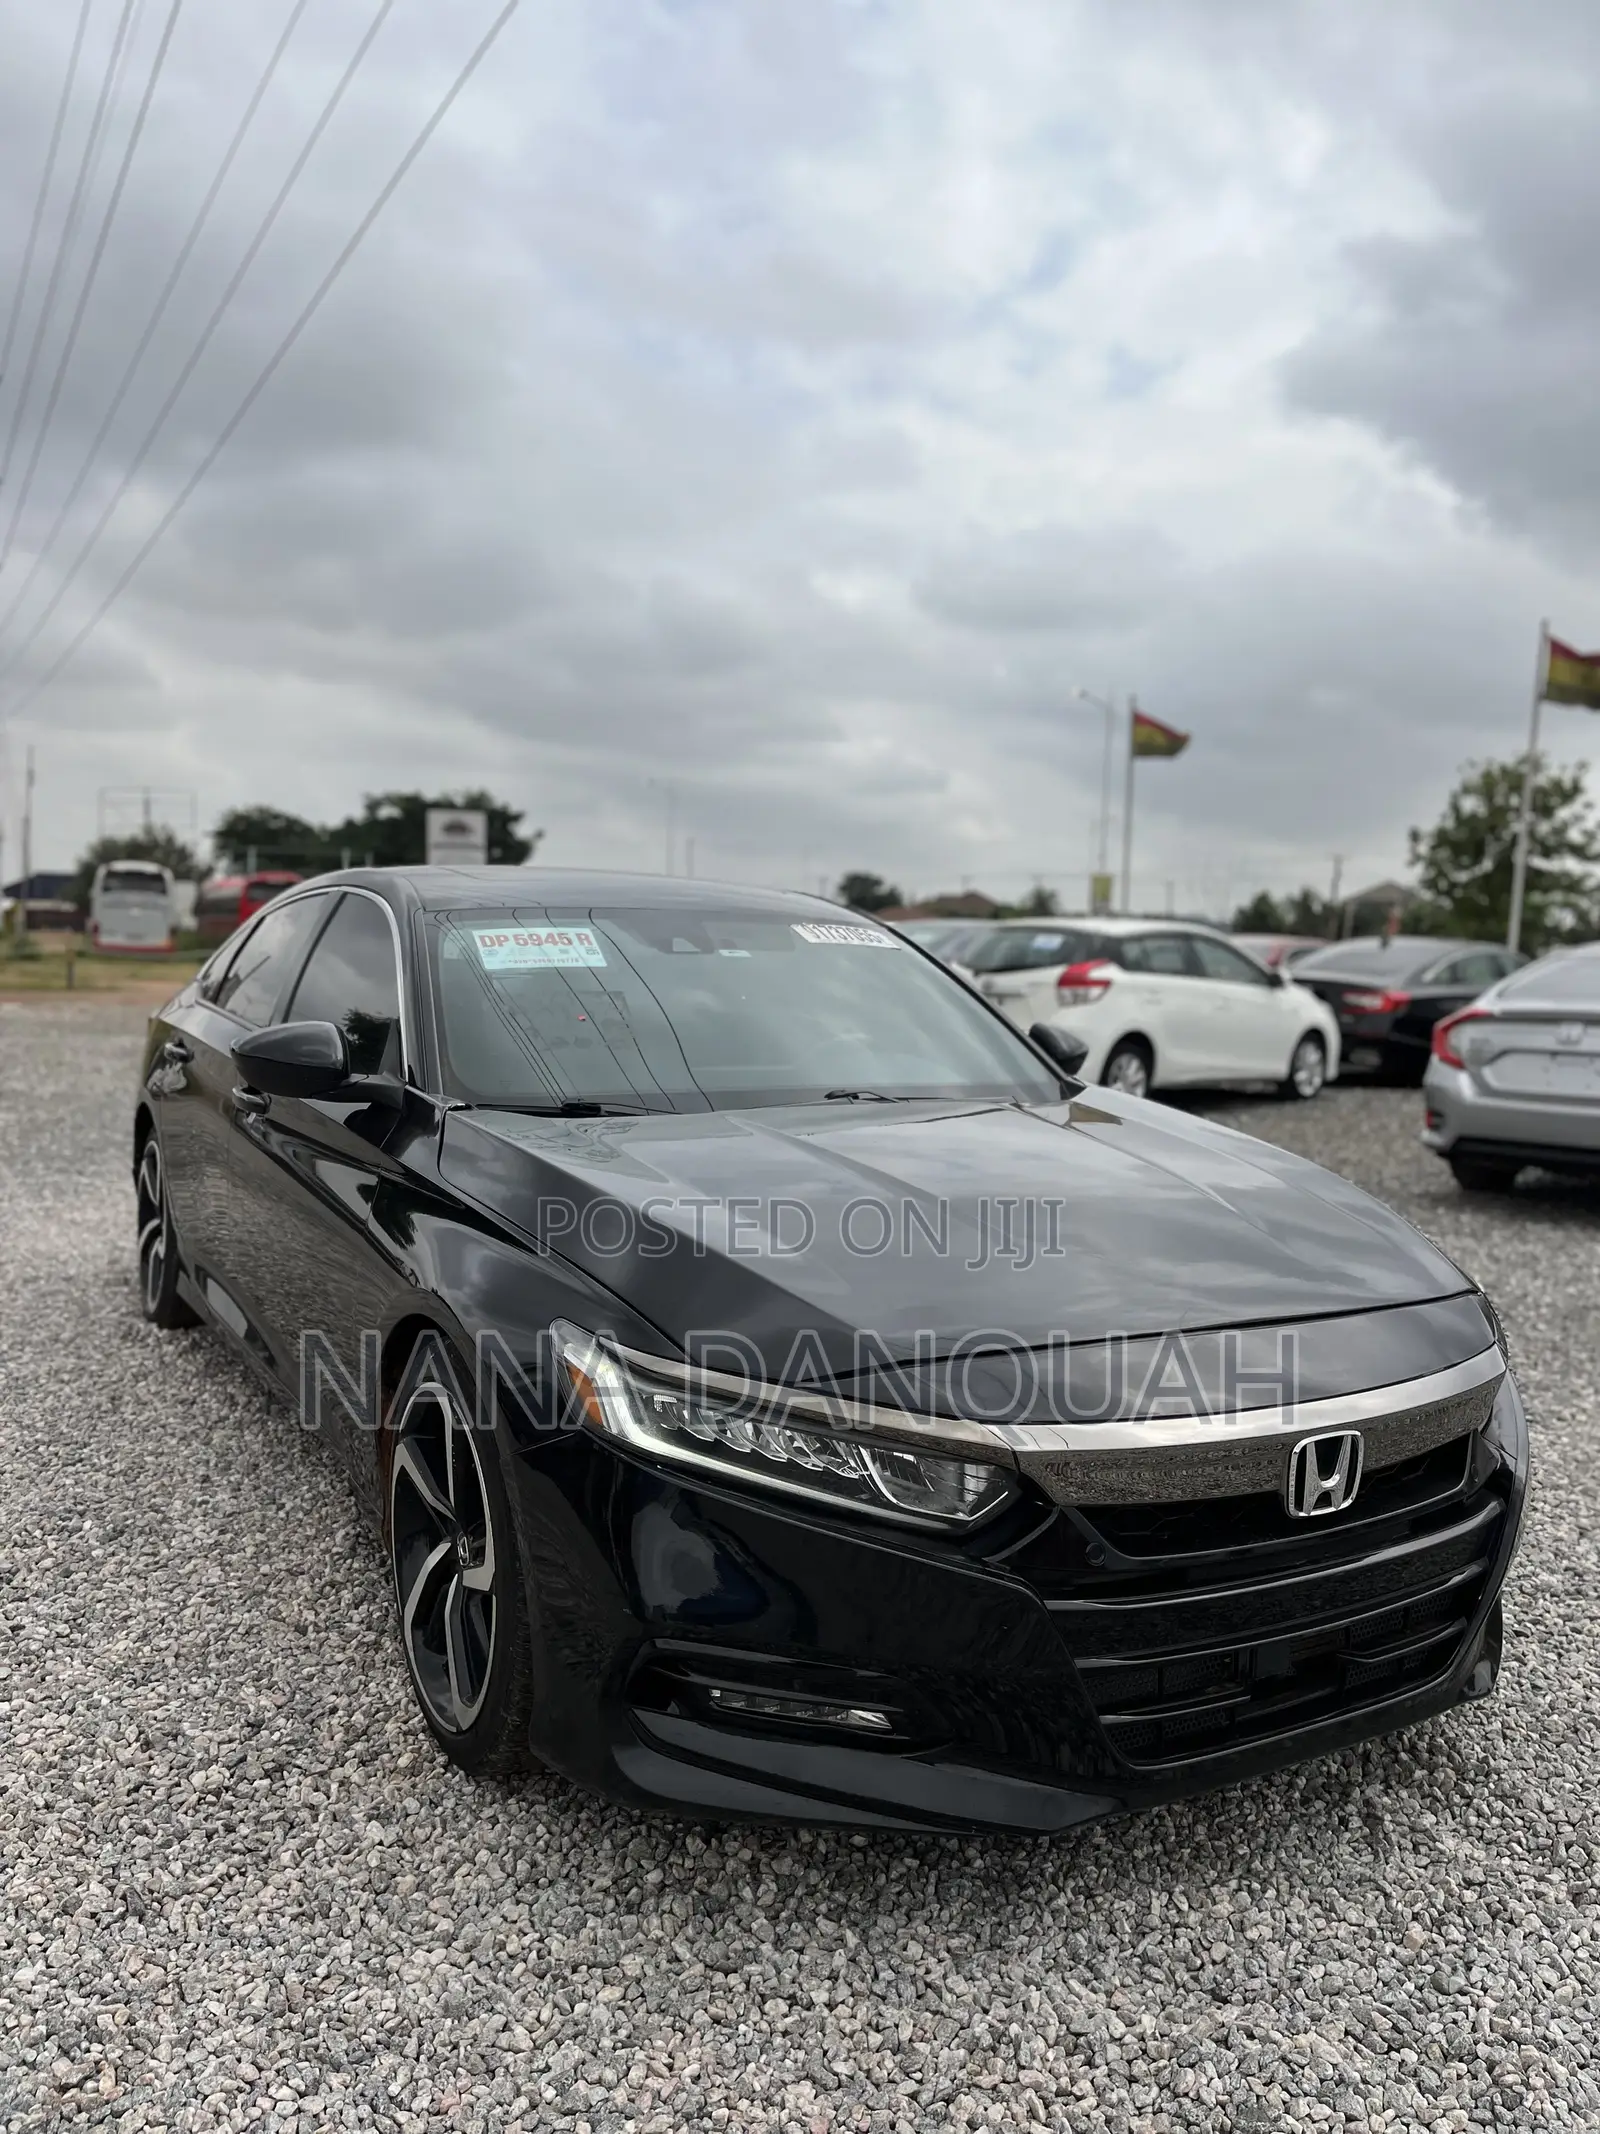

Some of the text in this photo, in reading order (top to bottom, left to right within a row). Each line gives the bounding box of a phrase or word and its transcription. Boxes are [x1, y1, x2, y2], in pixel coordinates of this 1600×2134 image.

[478, 932, 593, 948] DP 5945 R
